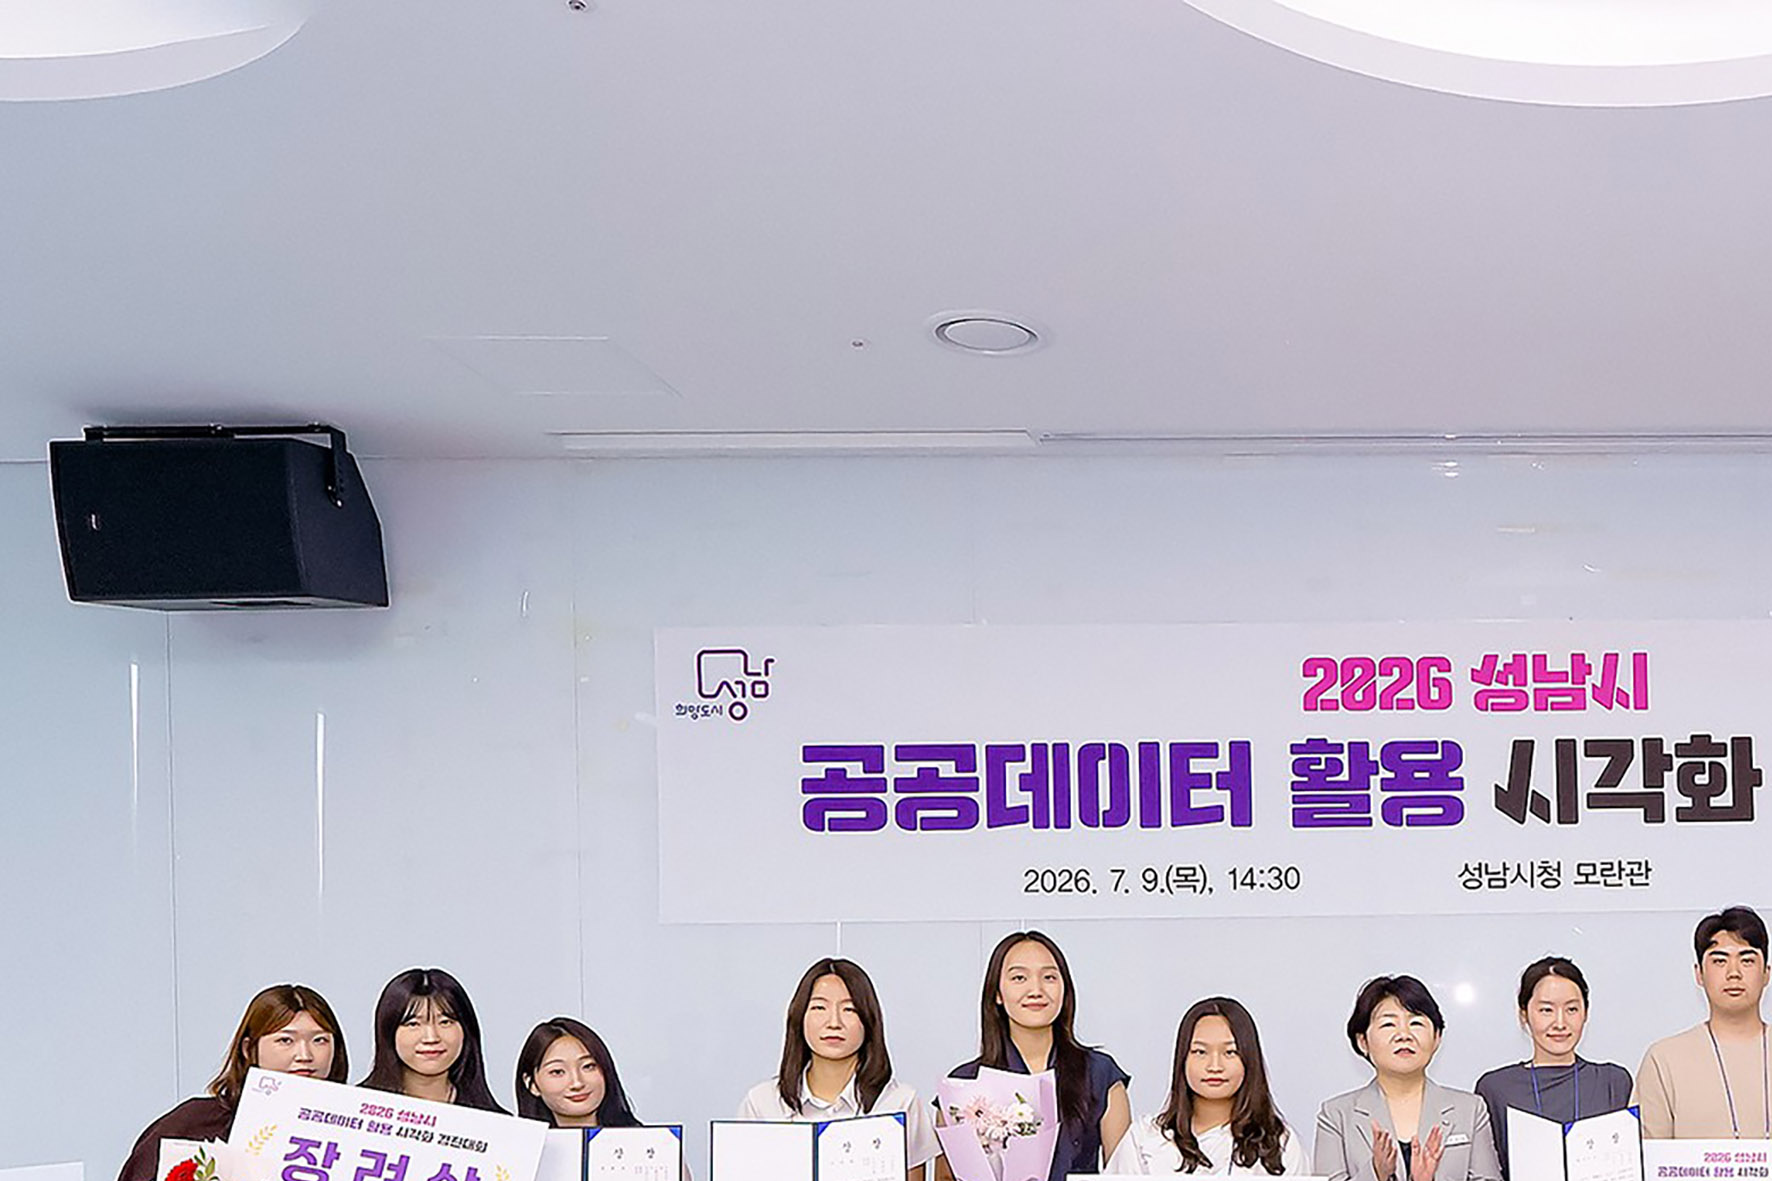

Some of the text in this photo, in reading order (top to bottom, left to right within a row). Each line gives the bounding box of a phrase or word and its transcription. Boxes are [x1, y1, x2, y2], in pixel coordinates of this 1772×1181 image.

[1303, 652, 1648, 712] 2026 성남시
[801, 741, 1252, 832] 공공데이터
[1290, 738, 1465, 828] 활용
[1494, 734, 1762, 826] 시각화
[1024, 864, 1300, 895] 2026. 7. 9.(목), 14:30
[1458, 860, 1653, 890] 성남시청 모란관
